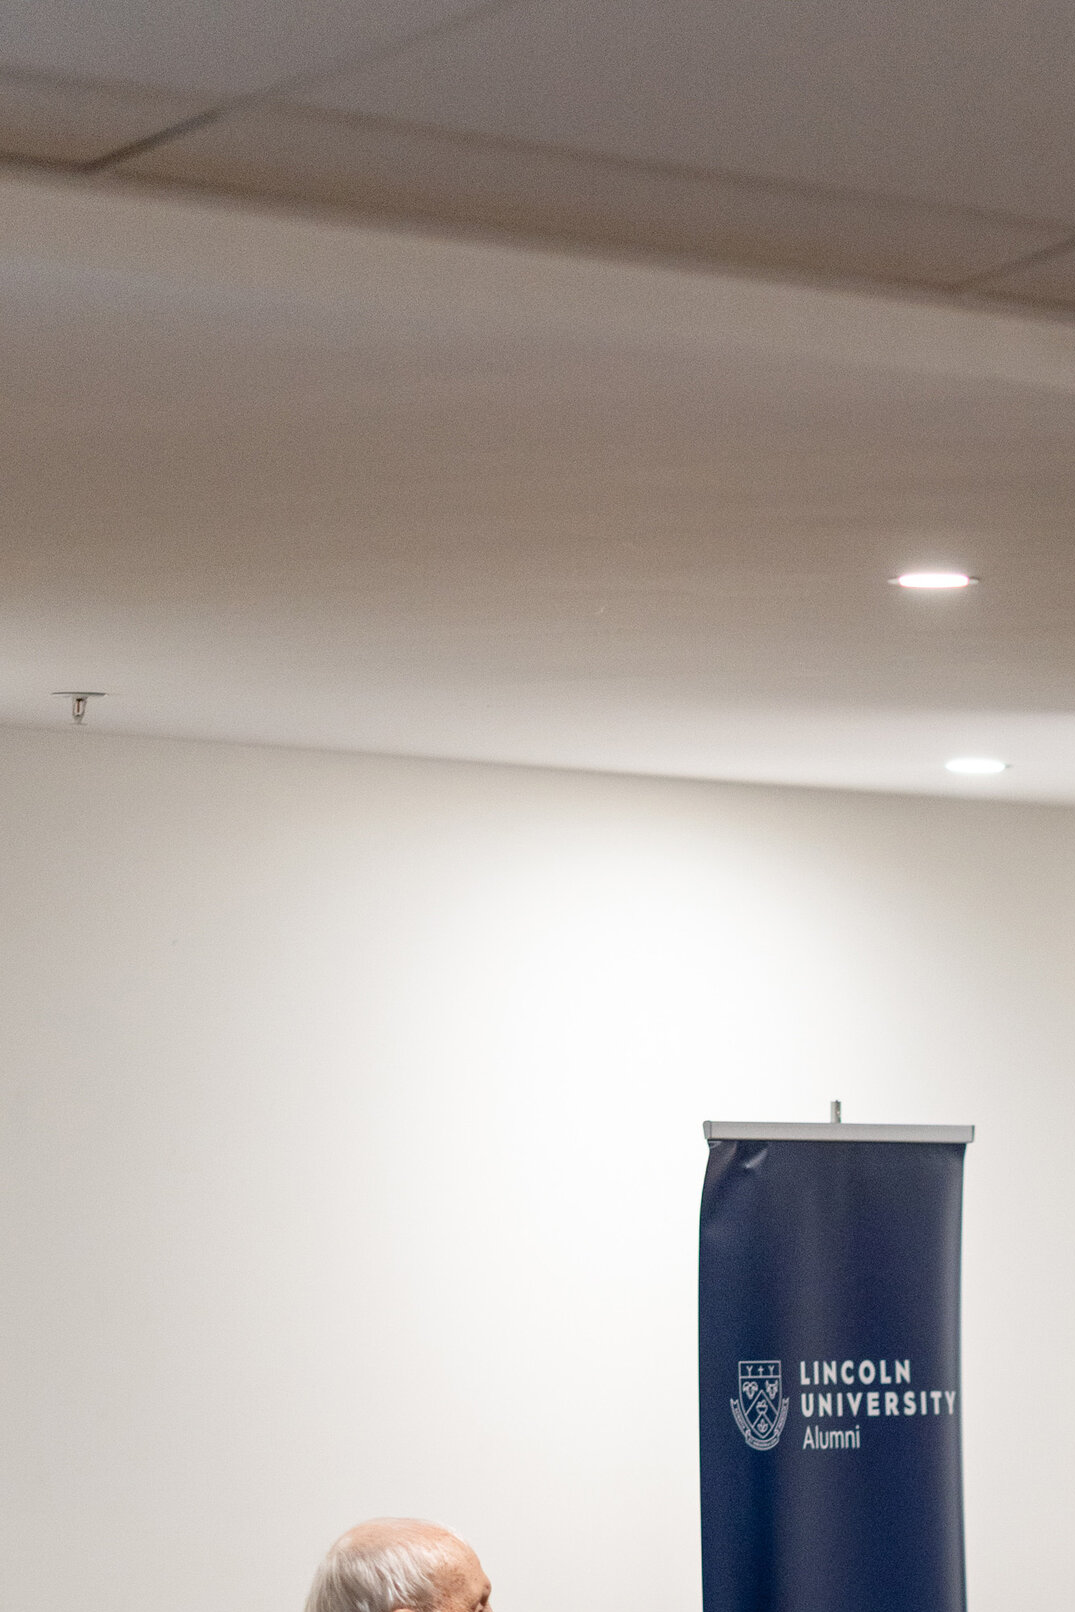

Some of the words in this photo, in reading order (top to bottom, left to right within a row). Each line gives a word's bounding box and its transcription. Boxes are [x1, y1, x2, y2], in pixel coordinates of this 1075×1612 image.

[800, 1359, 911, 1385] LINCOLN
[800, 1391, 956, 1417] UNIVERSITY
[802, 1425, 861, 1450] Alumni
